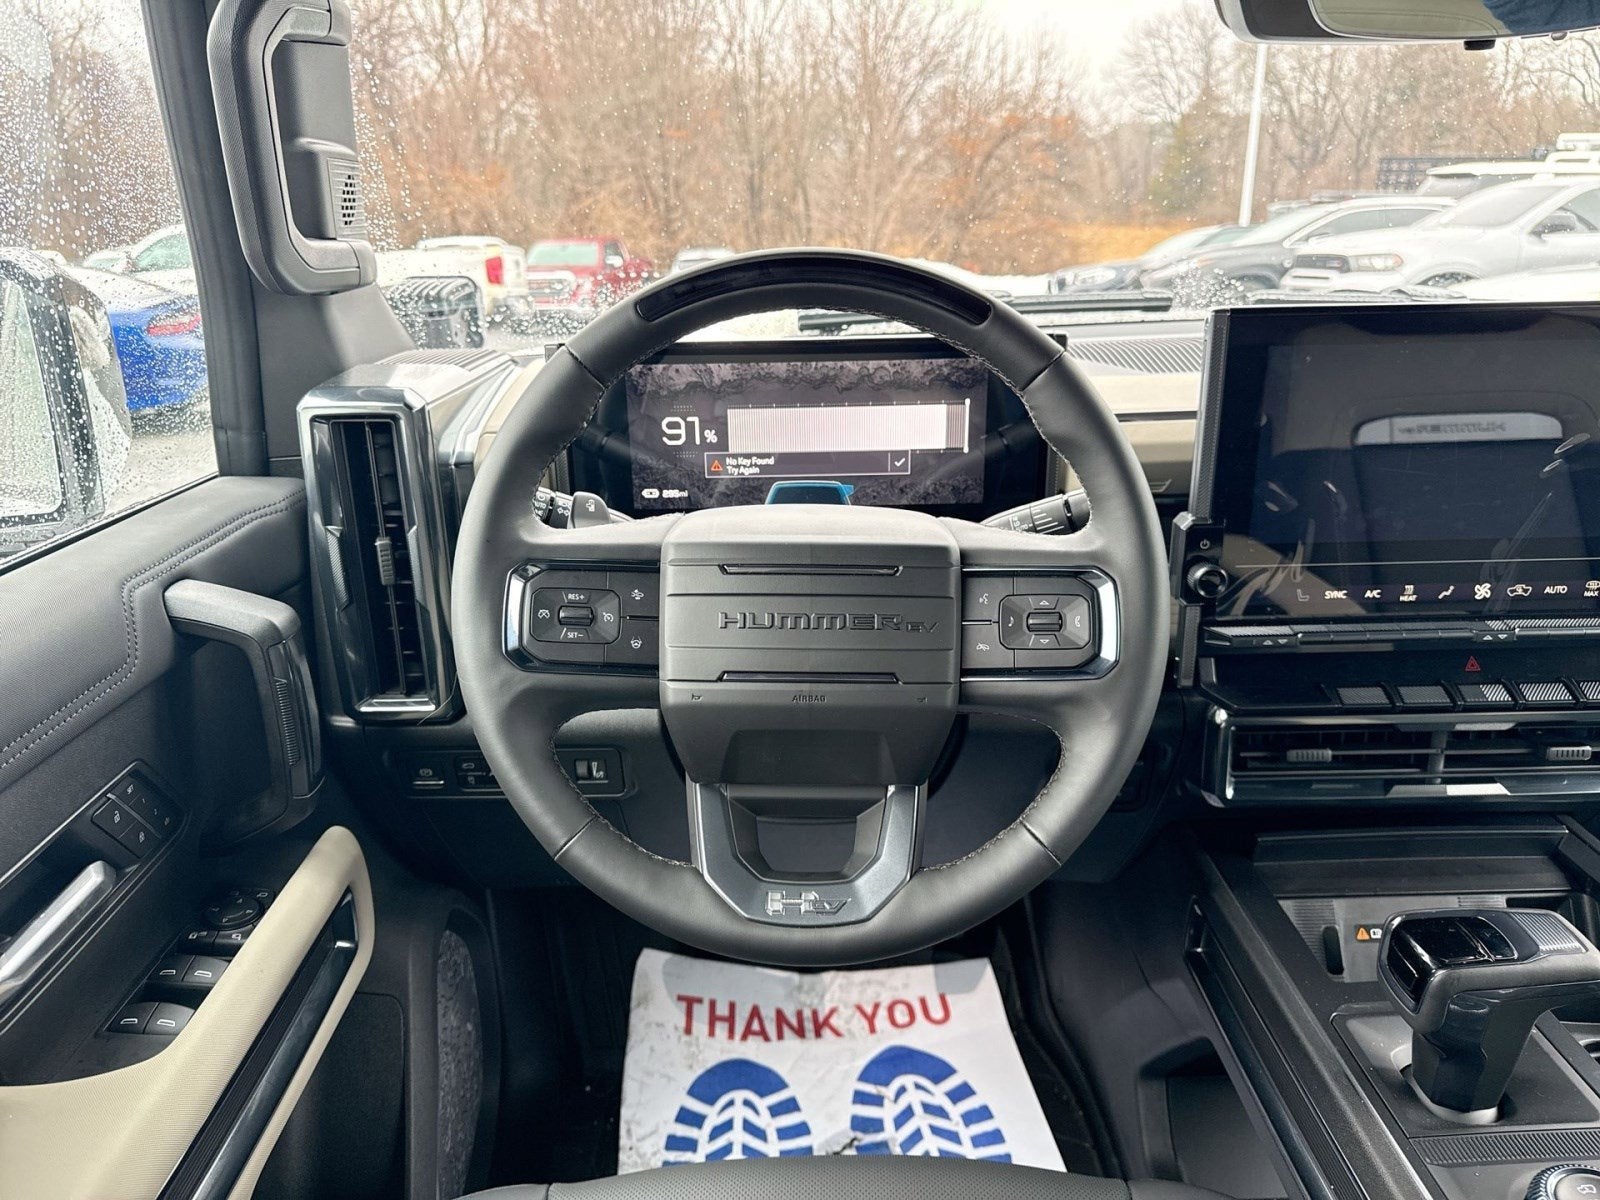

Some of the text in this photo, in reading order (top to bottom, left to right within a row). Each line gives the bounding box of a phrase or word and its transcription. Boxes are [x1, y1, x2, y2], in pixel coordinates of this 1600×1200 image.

[726, 456, 775, 467] No Key Found
[726, 466, 760, 475] Try Again
[1364, 589, 1382, 598] A/C
[1543, 585, 1568, 594] AUTO
[1324, 590, 1348, 599] SYNC
[718, 611, 940, 633] HUMMER EV
[791, 694, 827, 704] AIRBAG
[676, 992, 952, 1043] THANK YOU
